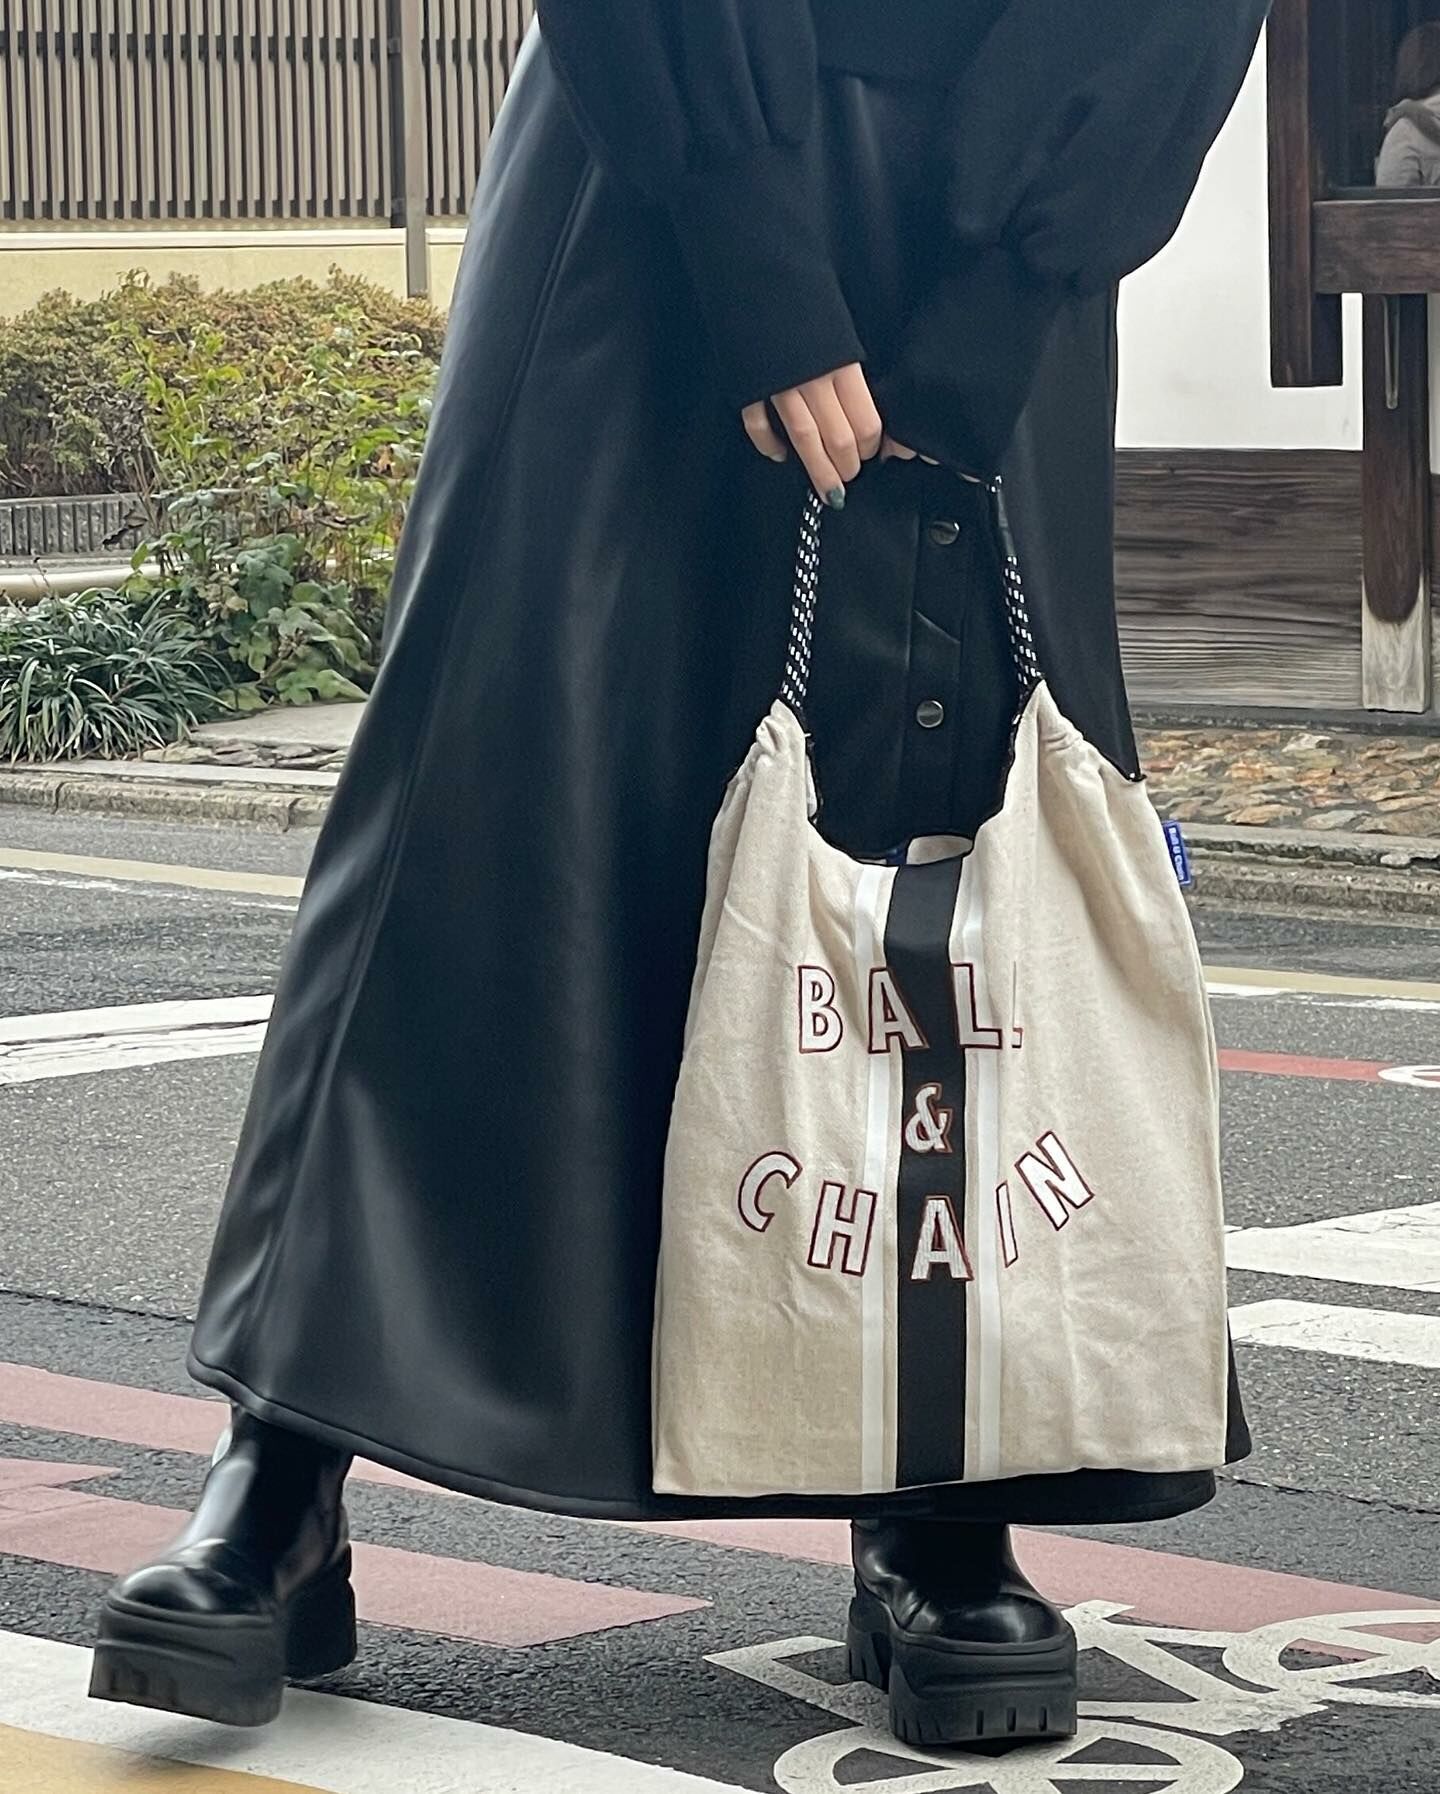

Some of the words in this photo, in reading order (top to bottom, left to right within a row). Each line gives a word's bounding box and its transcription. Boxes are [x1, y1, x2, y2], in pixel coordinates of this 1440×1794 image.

[798, 961, 1023, 1053] BAL
[905, 1083, 953, 1153] &
[738, 1131, 1095, 1281] CHAIN
